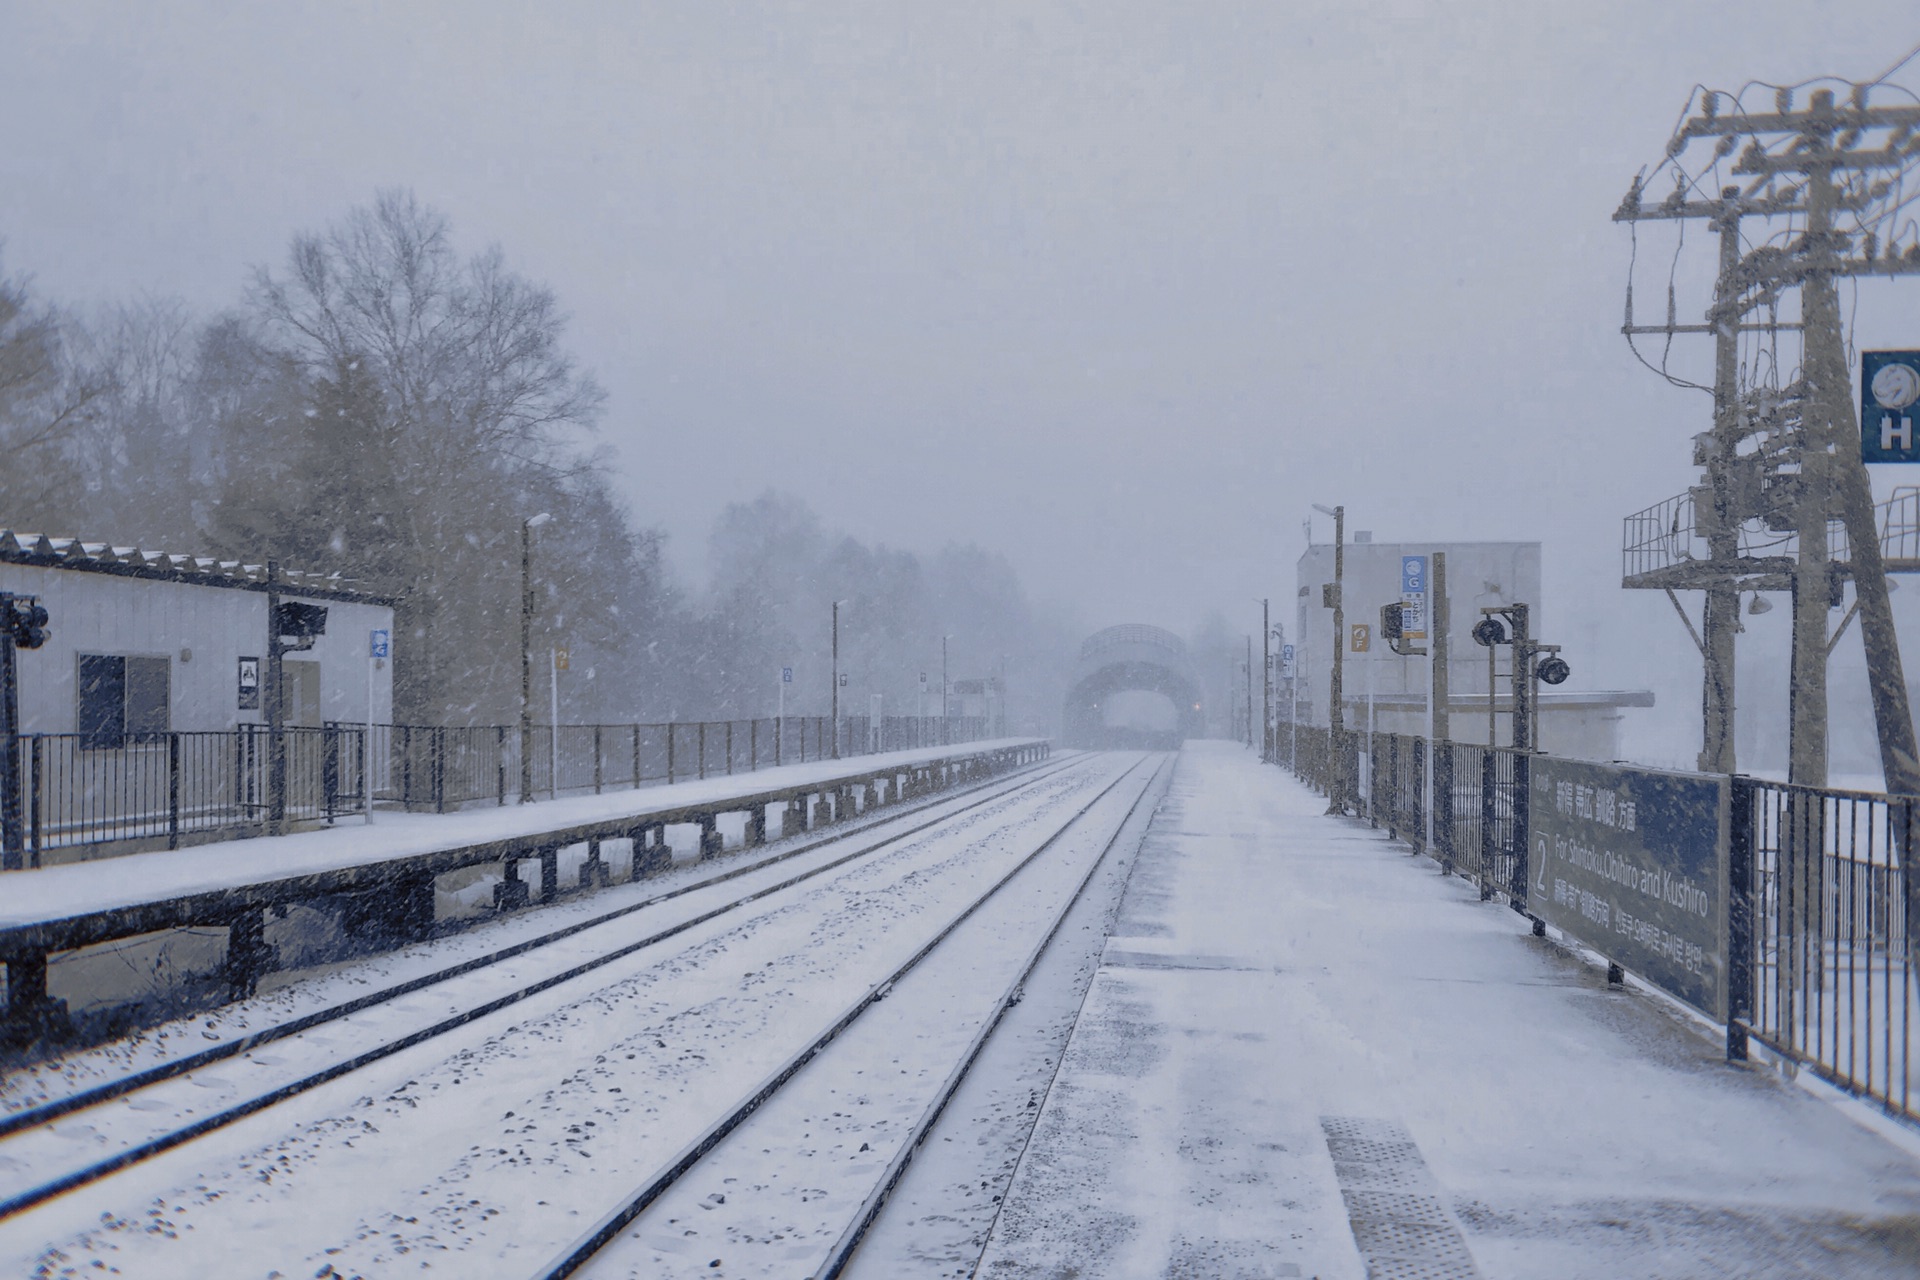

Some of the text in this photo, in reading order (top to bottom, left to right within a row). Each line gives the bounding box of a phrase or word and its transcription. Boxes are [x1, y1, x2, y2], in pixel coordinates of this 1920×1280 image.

[1881, 416, 1912, 450] H
[1408, 577, 1419, 588] G
[1356, 640, 1363, 649] F
[1556, 780, 1636, 833] 新得 帯広 釧路 方面
[1537, 839, 1545, 891] 2
[1555, 833, 1568, 860] For
[1640, 868, 1661, 899] and
[1663, 871, 1709, 918] Kushiro
